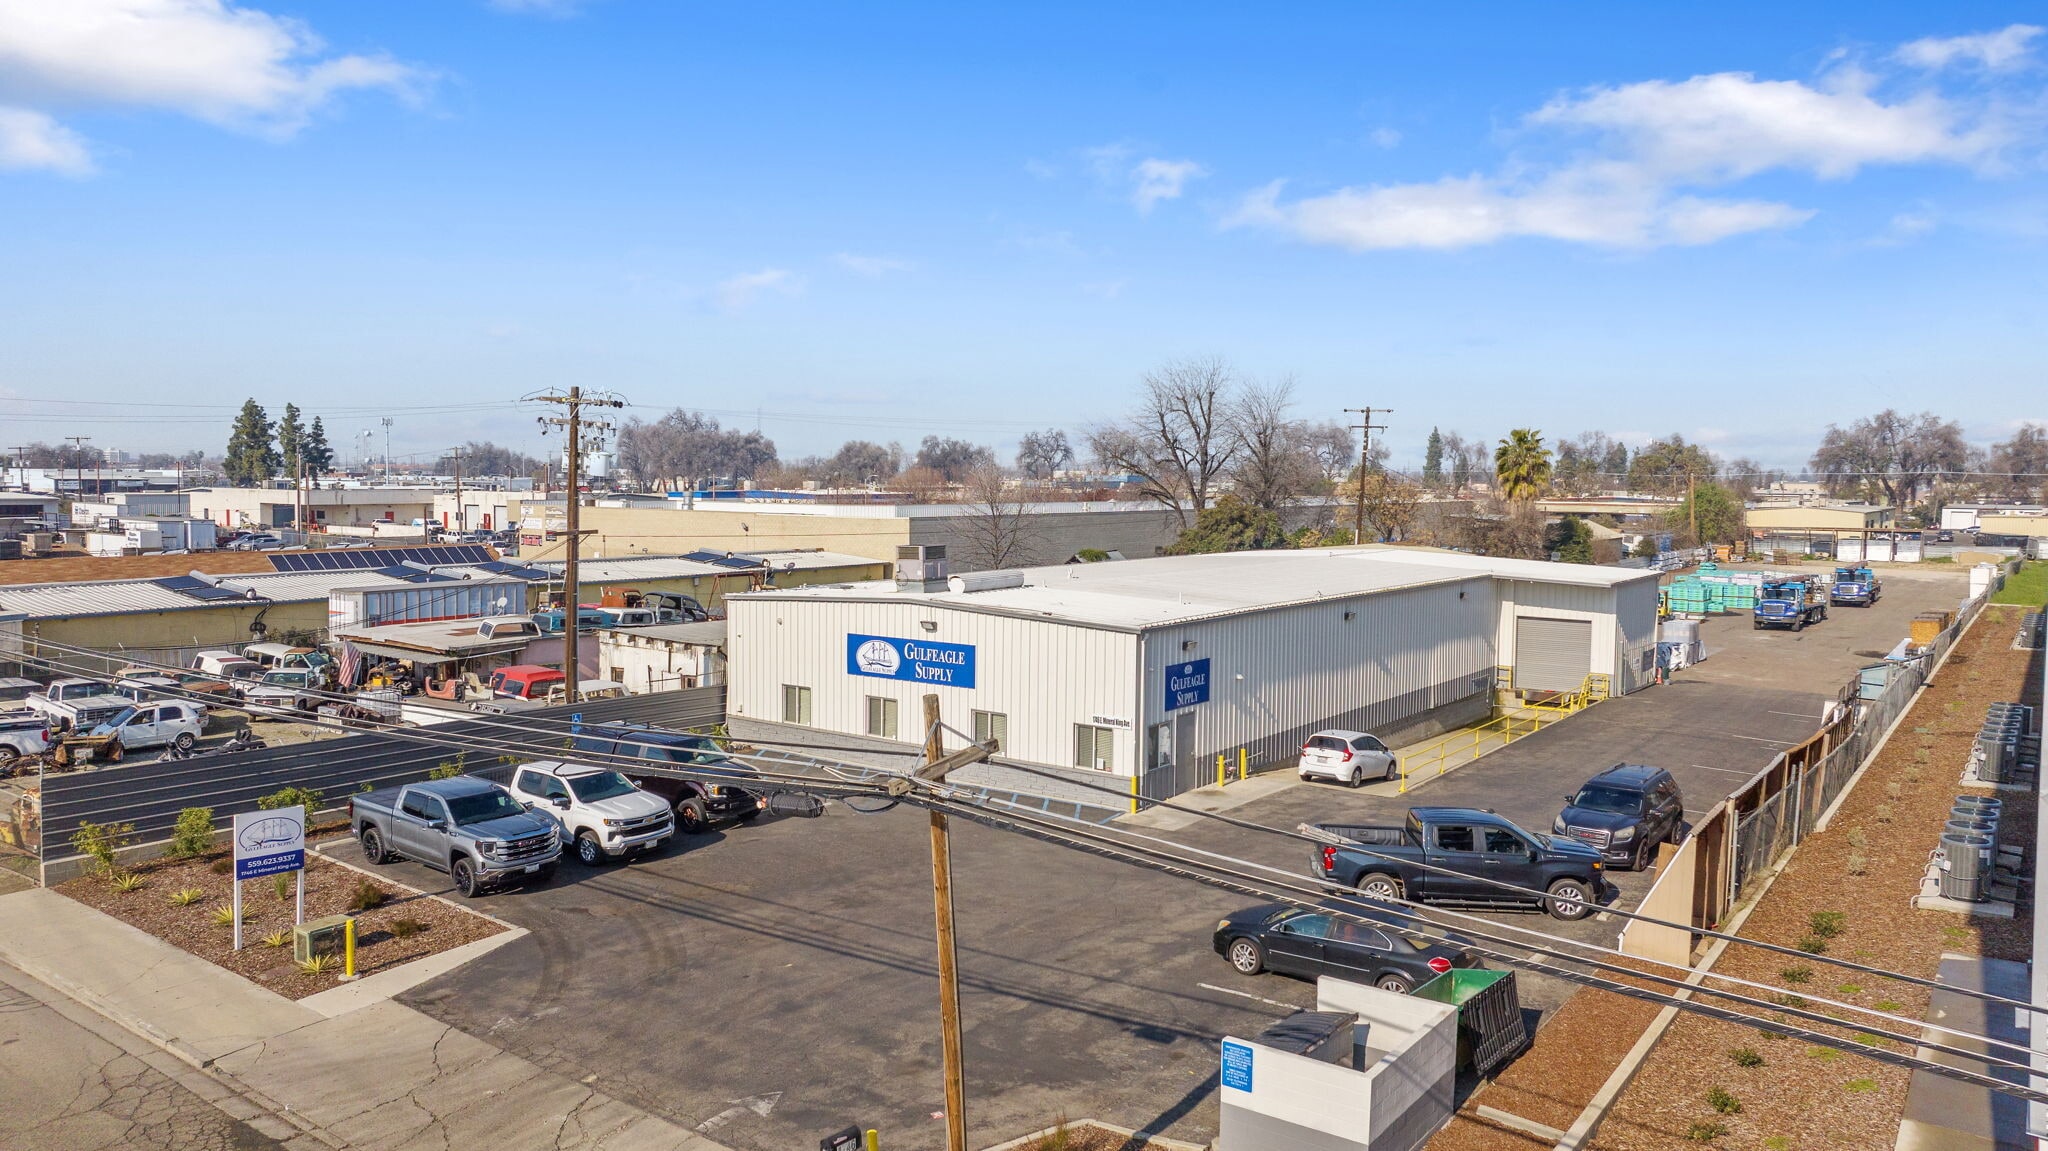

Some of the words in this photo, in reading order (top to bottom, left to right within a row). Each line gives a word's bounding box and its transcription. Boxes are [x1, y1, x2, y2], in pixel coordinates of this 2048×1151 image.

[904, 642, 965, 665] GULFEAGLE
[915, 662, 953, 682] SUPPLY
[1171, 674, 1205, 691] GULFEAGLE
[1177, 690, 1199, 706] SUPPLY
[247, 854, 296, 868] 559.623.9337
